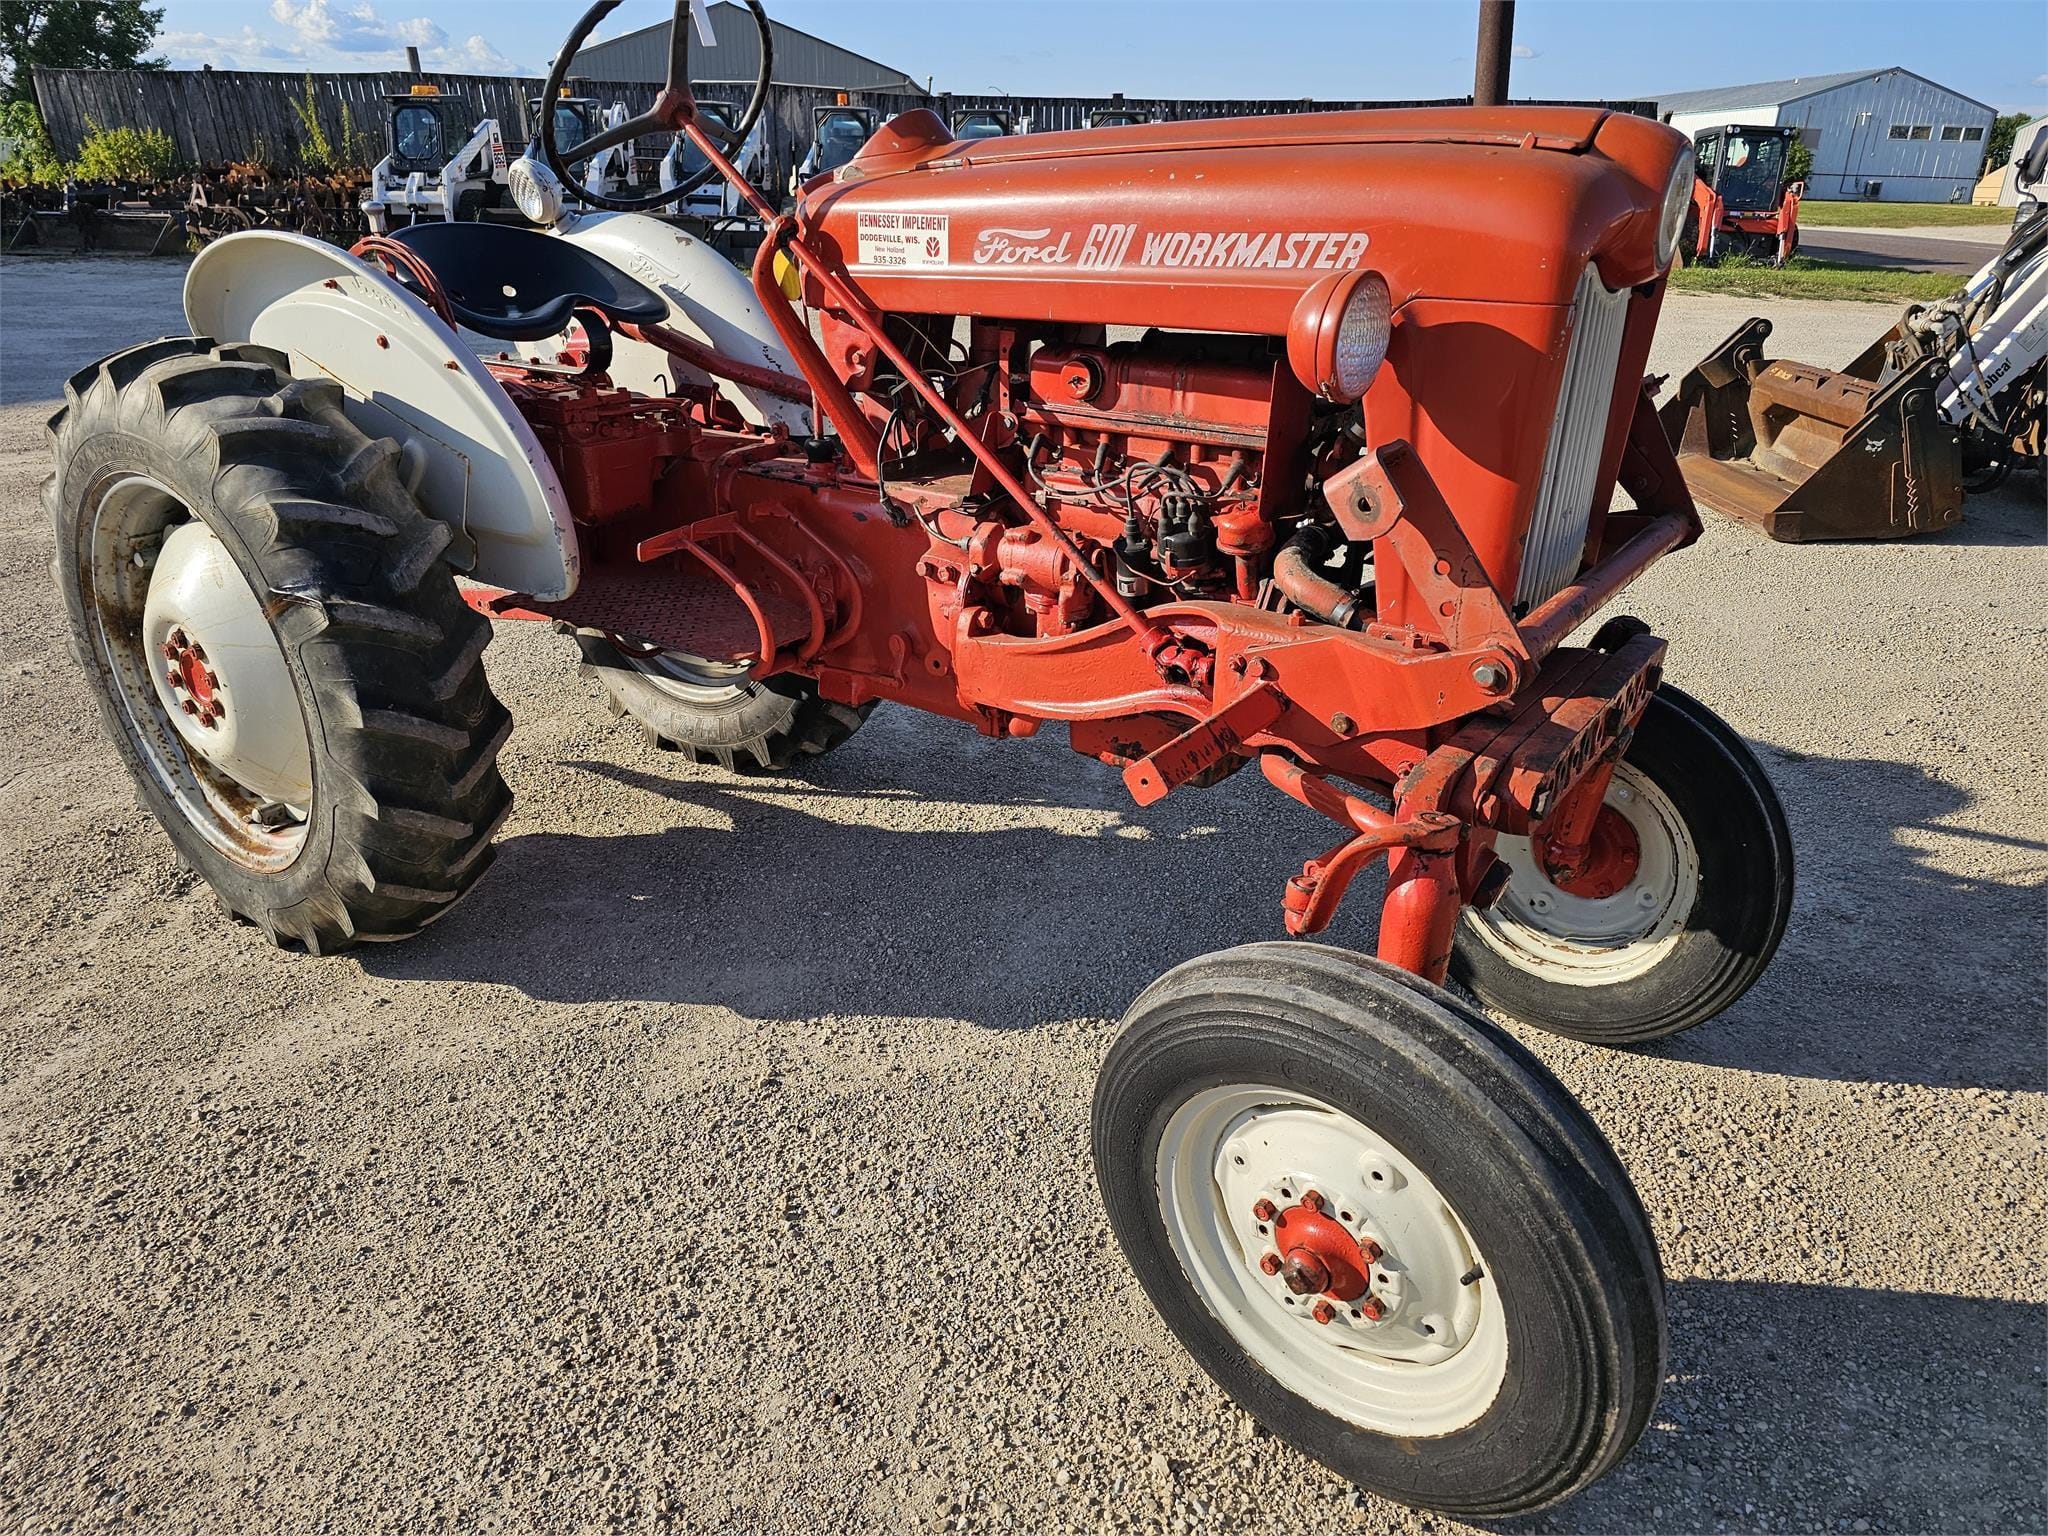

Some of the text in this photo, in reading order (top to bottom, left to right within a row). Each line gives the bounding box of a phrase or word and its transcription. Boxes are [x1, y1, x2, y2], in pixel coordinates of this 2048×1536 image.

[859, 213, 947, 231] HENNESSEY IMPLEMENT
[860, 233, 920, 244] DODGEVILLE, WIS.
[886, 246, 905, 254] Holland
[973, 223, 1370, 272] Ford 601 WORKMASTER
[873, 255, 907, 265] 935-3326
